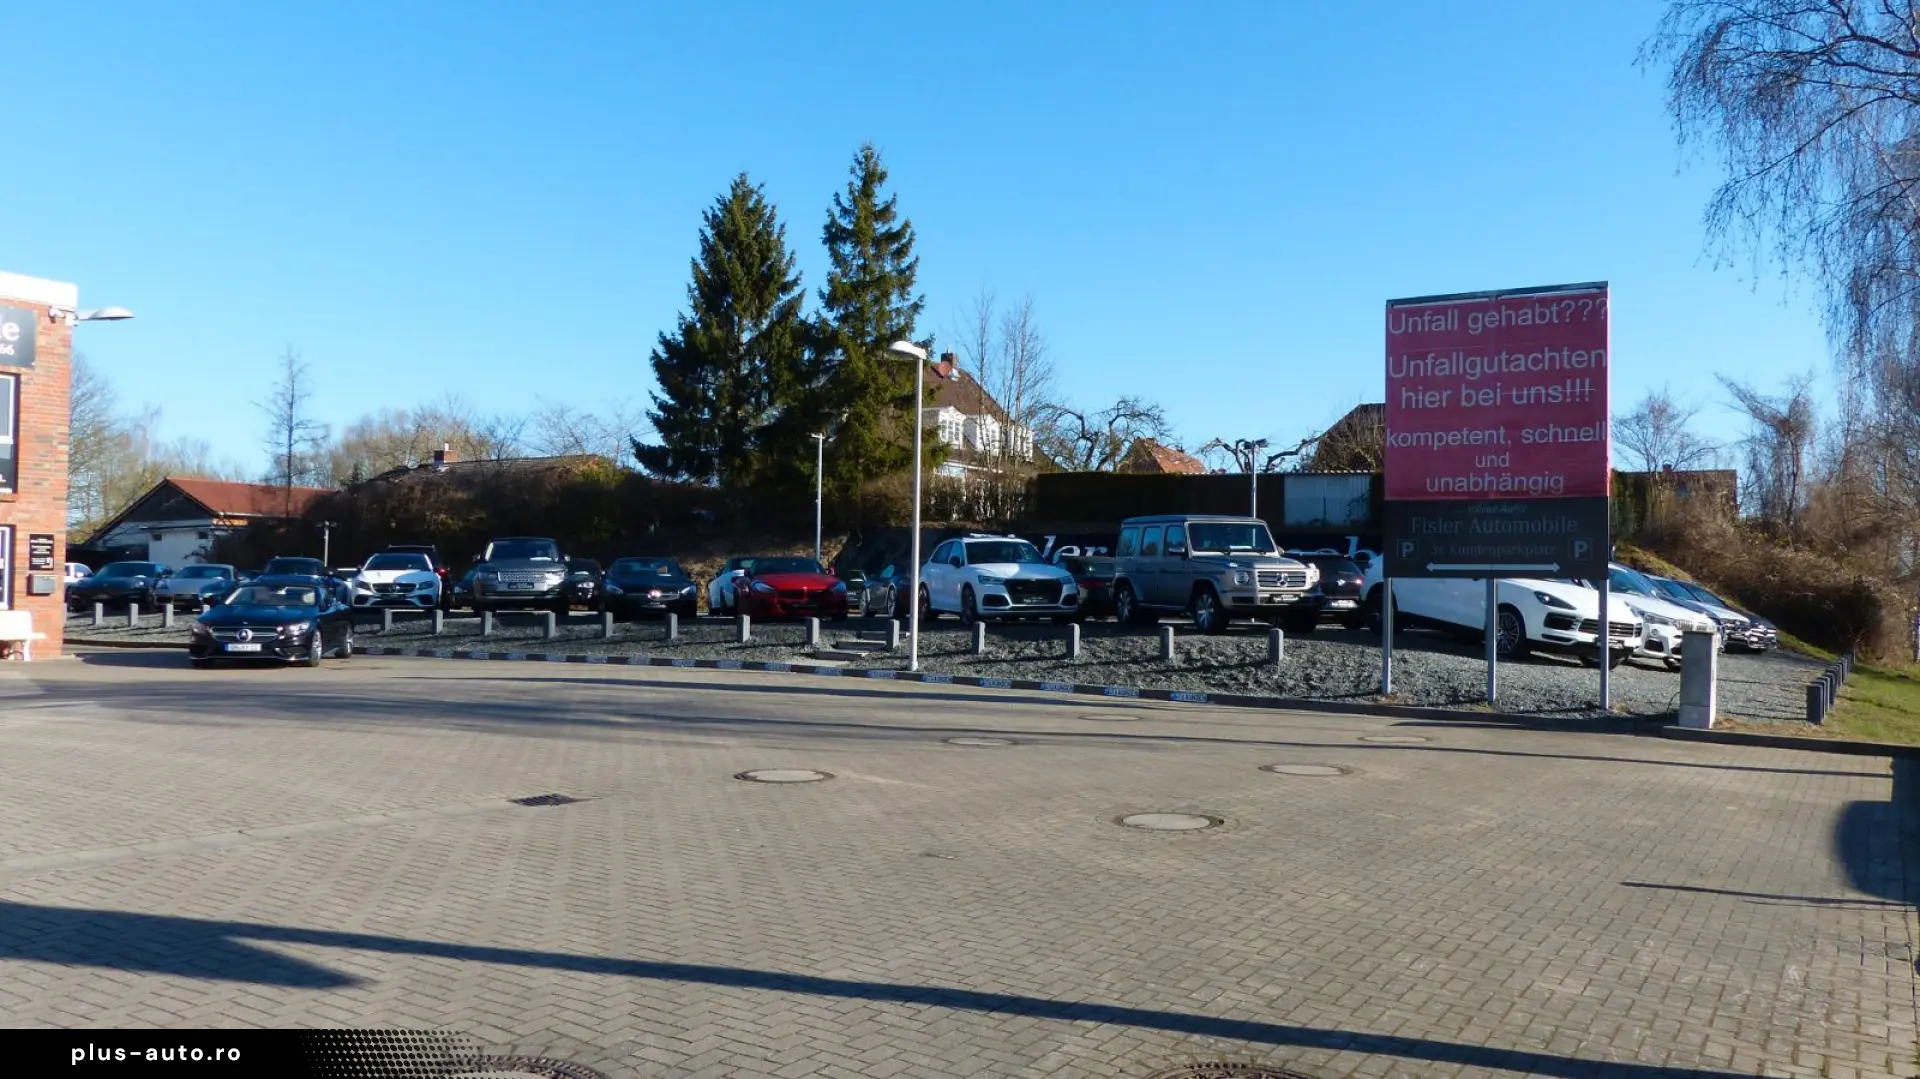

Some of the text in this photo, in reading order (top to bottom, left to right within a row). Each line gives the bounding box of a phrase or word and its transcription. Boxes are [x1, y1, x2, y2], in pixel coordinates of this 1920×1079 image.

[1388, 298, 1608, 336] Unfall gehabt???
[1388, 346, 1607, 380] Unfallgutachten
[1401, 378, 1591, 410] hier bei uns!!!
[1386, 421, 1606, 450] kompetent, schnell
[1475, 452, 1510, 468] und
[1426, 471, 1565, 496] unabhängig
[1469, 515, 1579, 534] Automobile
